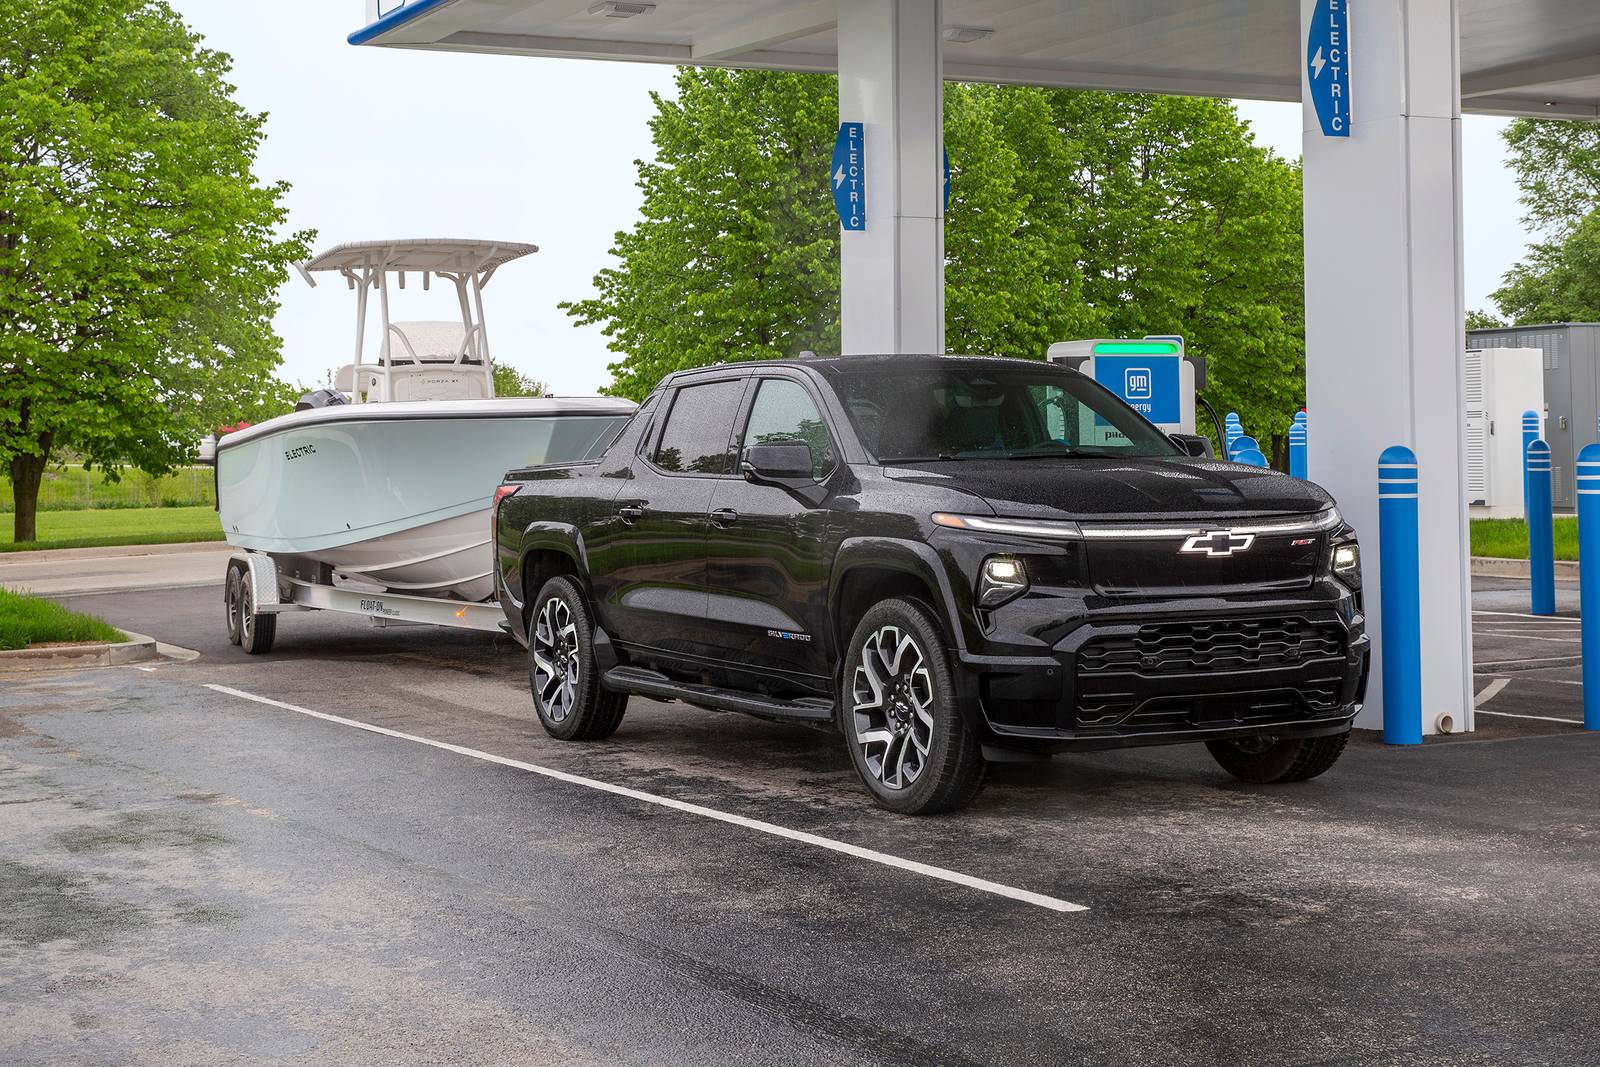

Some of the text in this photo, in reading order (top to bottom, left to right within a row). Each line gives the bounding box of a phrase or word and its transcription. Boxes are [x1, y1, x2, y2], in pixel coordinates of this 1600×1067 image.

[1329, 0, 1342, 131] ELECTRIC
[849, 127, 859, 227] ELECTRIC
[1129, 375, 1147, 391] gm
[1128, 403, 1152, 412] nergy
[285, 444, 316, 460] ELECTRIC
[360, 599, 384, 611] FLOAT-ON
[767, 629, 811, 641] SILVERADO
